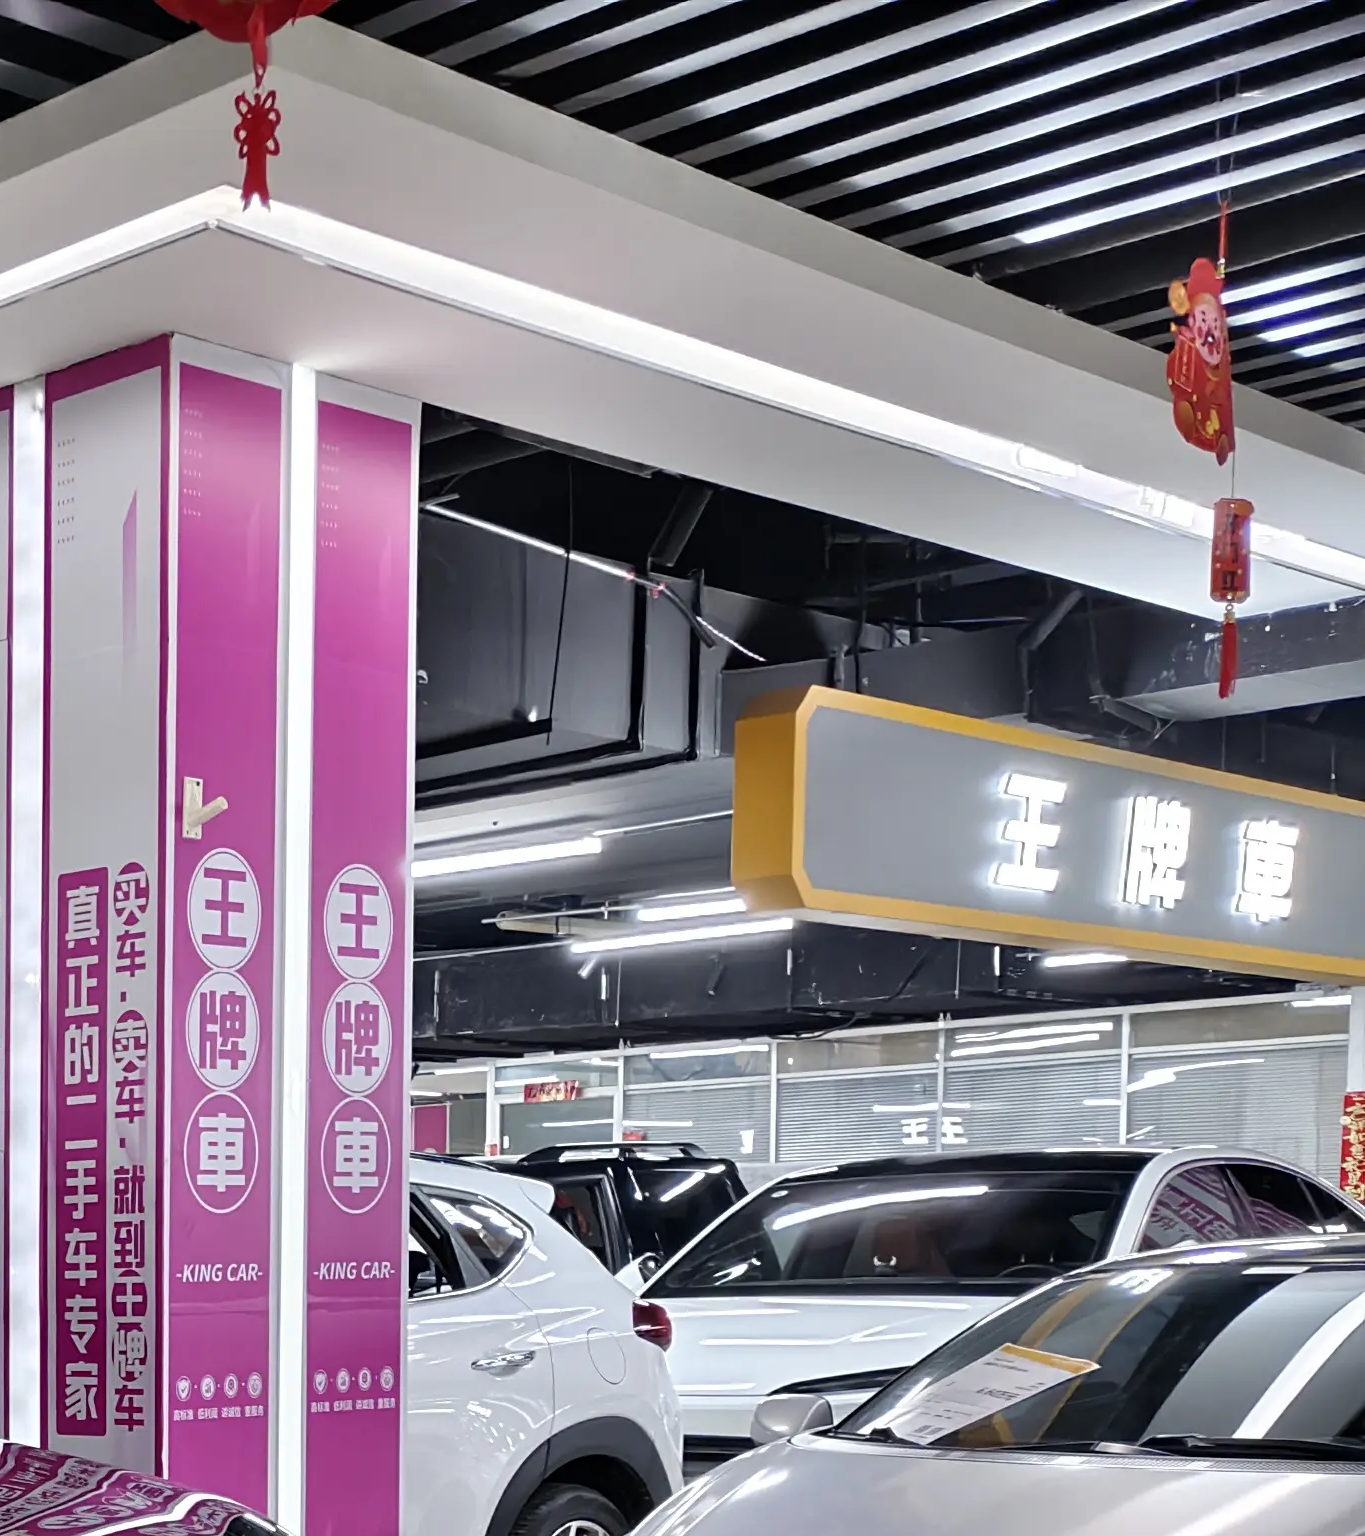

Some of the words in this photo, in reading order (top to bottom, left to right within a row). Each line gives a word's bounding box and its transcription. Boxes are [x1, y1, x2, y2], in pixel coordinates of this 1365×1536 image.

[993, 772, 1300, 922] 王牌車
[63, 886, 101, 1422] 真正的二手车专家
[195, 866, 249, 1194] 王牌車
[333, 881, 382, 1195] 王牌車
